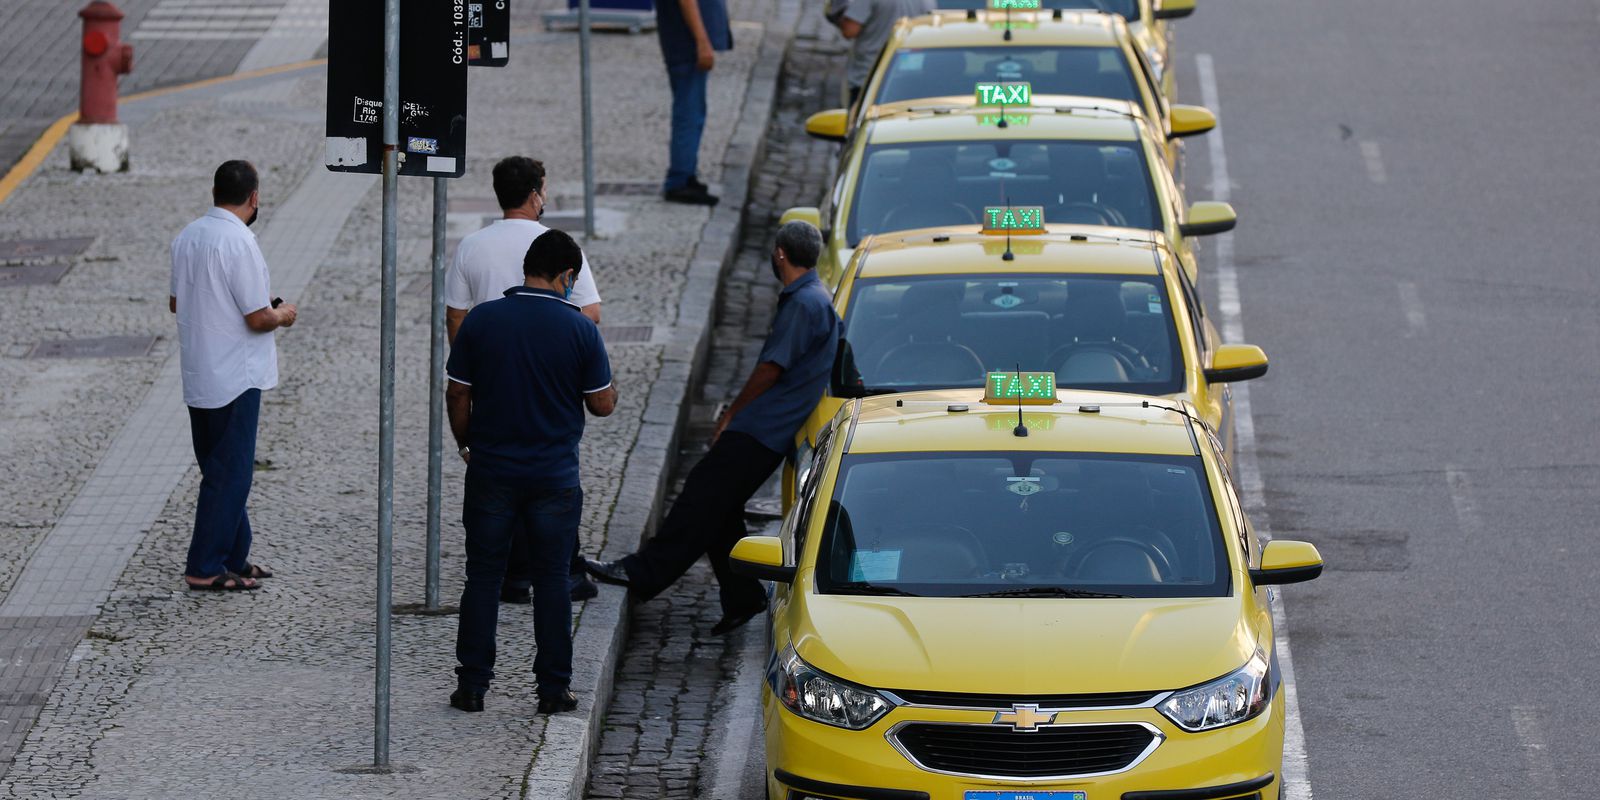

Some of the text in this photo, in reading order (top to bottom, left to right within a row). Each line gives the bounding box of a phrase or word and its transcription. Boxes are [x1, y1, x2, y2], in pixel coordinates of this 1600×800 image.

[452, 0, 463, 65] Cód.: 1032
[356, 97, 383, 108] Disque
[978, 85, 1029, 104] TAXI
[362, 107, 376, 115] Rio
[987, 209, 1040, 228] TAXI
[990, 374, 1053, 397] TAXI
